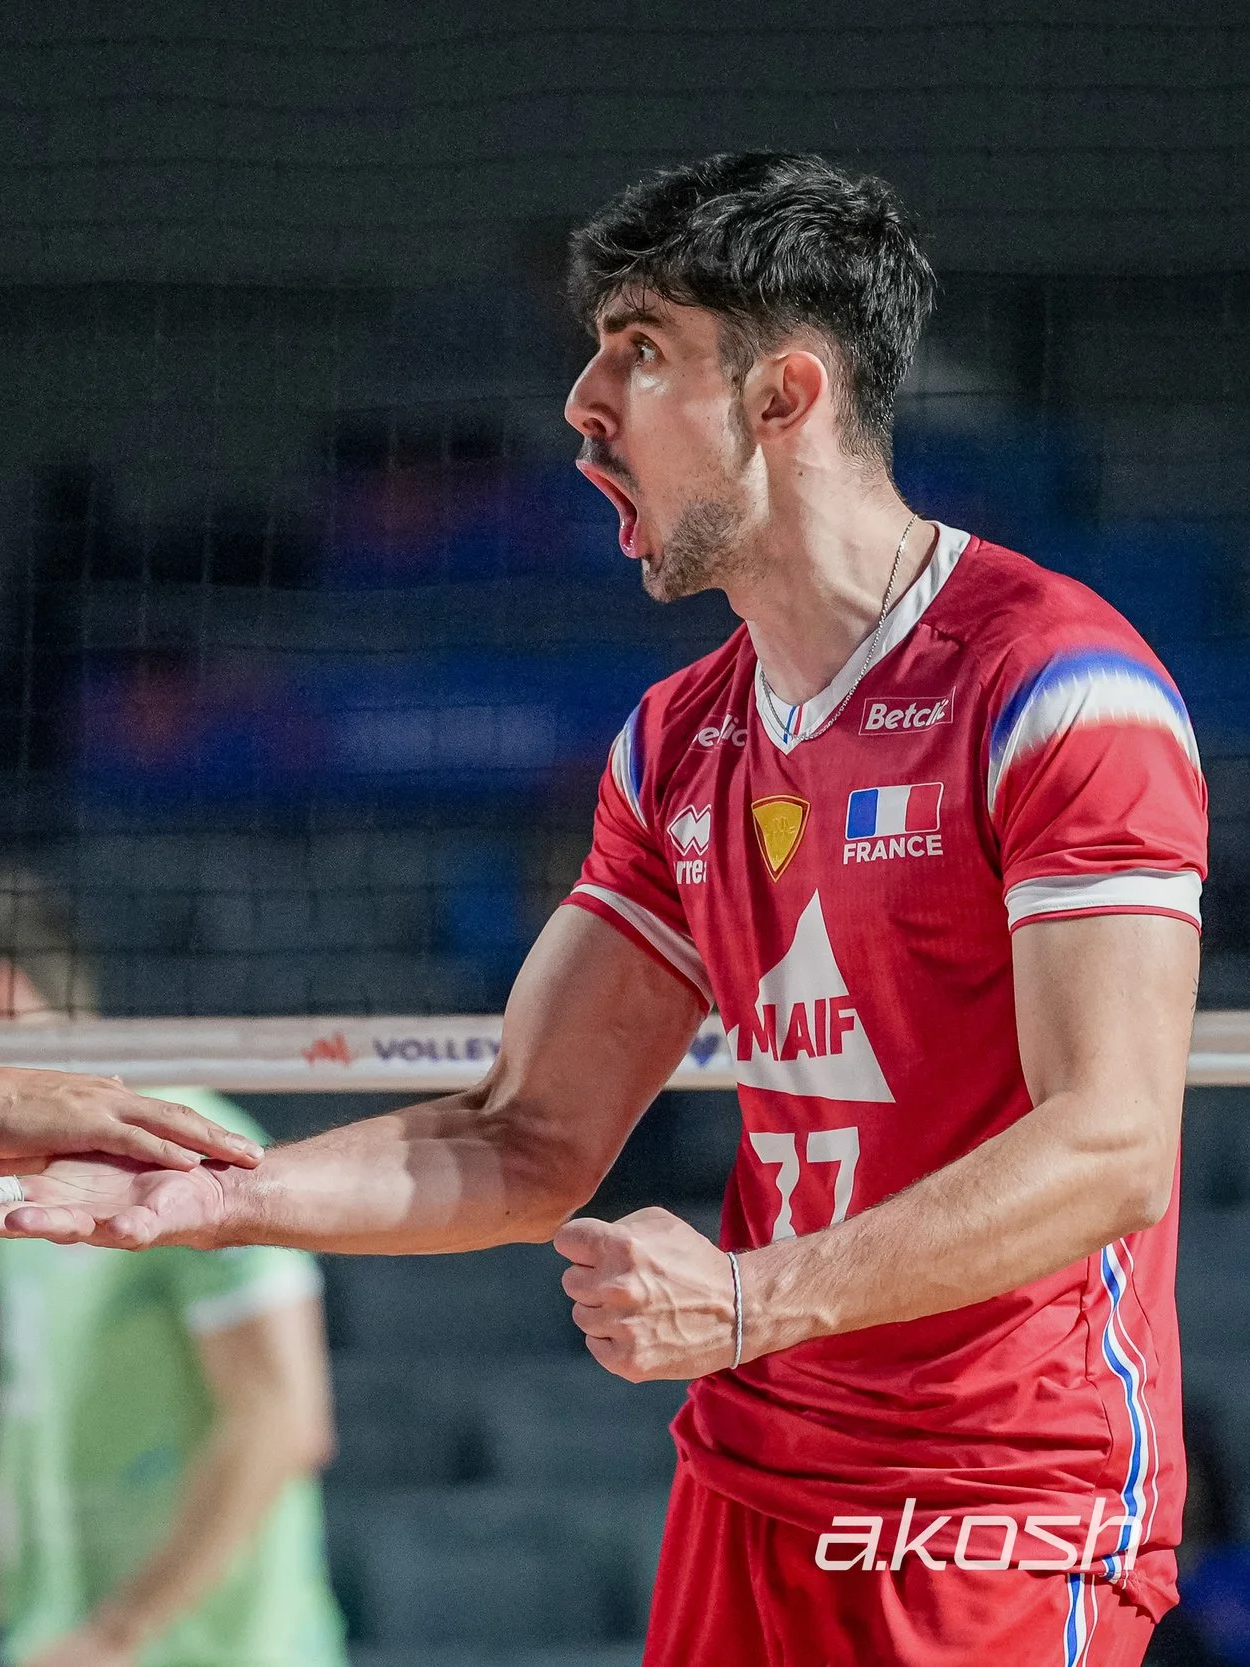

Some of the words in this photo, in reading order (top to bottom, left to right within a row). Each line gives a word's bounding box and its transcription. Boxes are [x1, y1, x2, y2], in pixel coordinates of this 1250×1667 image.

[843, 834, 944, 865] FRANCE
[737, 994, 856, 1062] MAIF
[749, 1126, 860, 1241] 77
